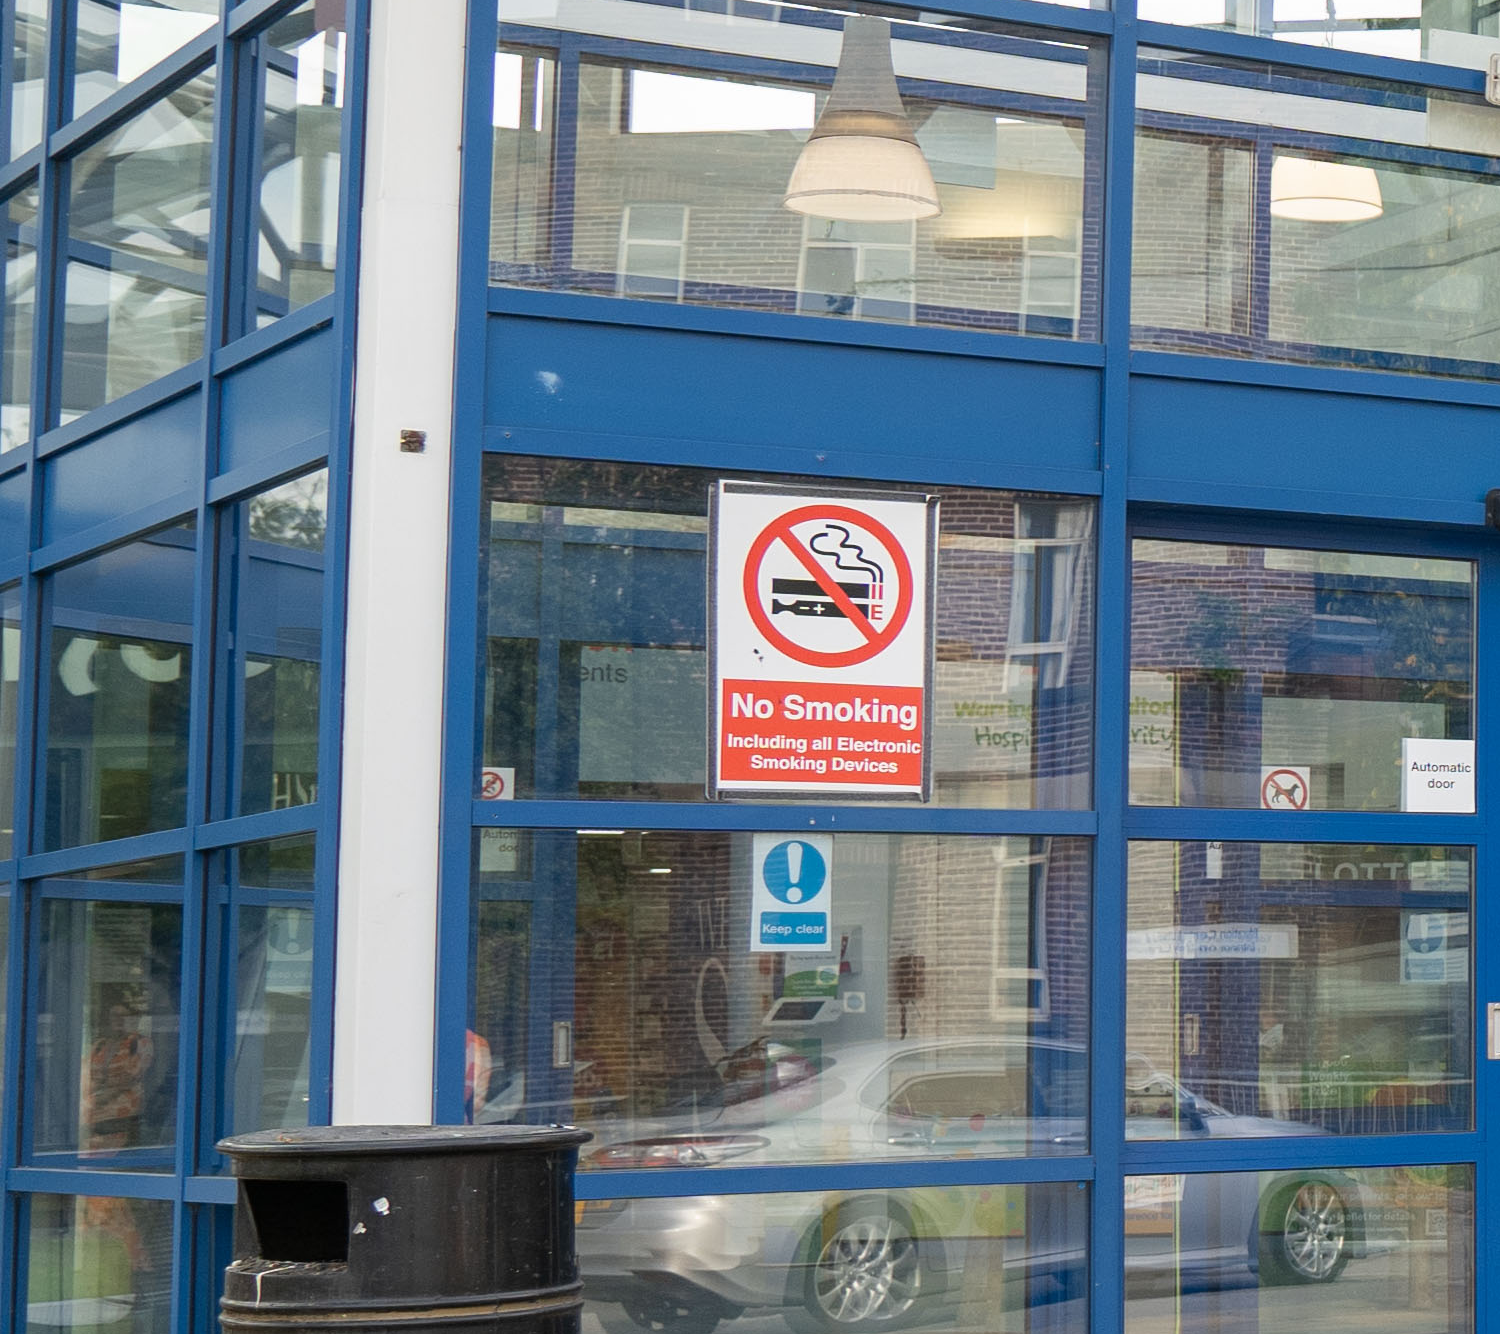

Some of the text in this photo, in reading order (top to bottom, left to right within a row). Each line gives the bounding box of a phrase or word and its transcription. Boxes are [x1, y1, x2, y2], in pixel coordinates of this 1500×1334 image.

[731, 692, 918, 730] No Smoking
[727, 733, 921, 754] Including all Electronic
[751, 754, 899, 774] Smoking Devices
[1410, 760, 1472, 774] Automatic
[1427, 777, 1456, 790] door
[762, 923, 825, 936] Keep clear
